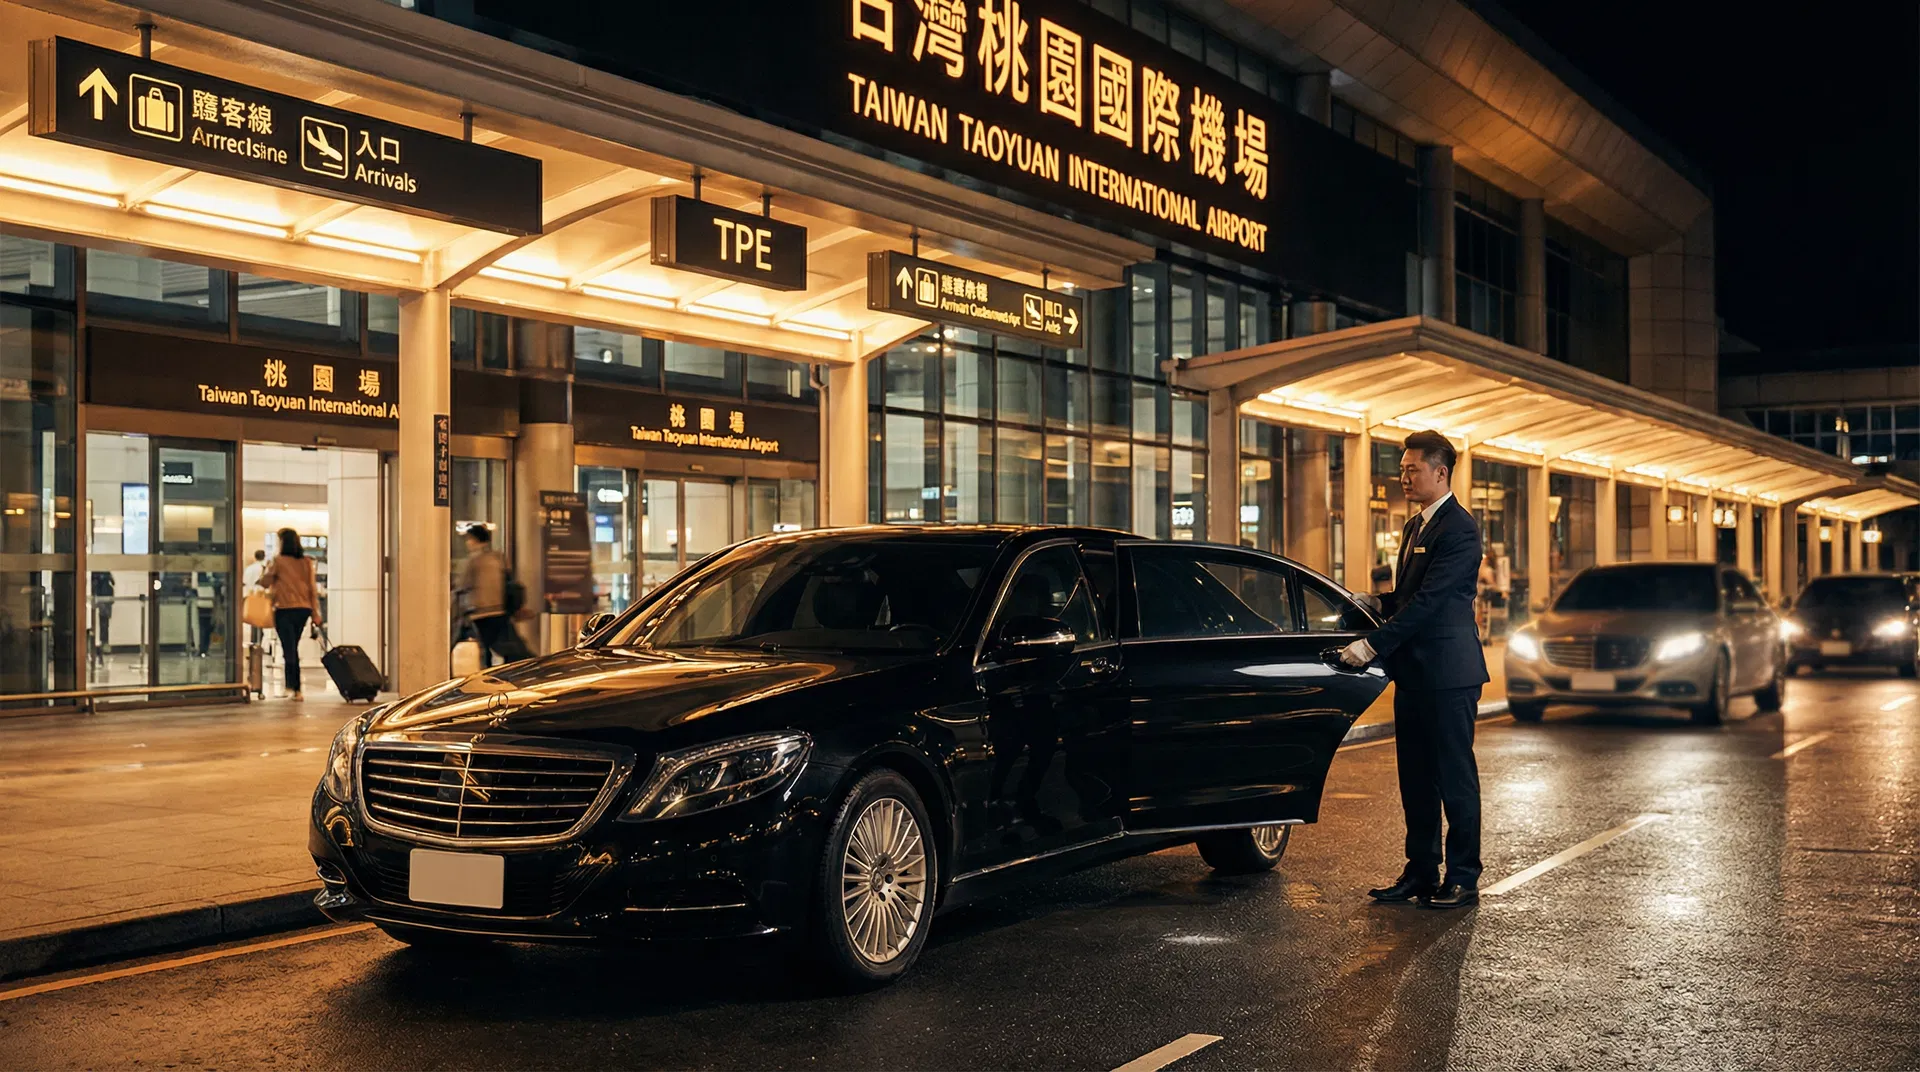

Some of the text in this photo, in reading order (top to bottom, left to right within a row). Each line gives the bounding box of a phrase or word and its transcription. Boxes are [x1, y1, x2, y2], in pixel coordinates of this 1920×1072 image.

[355, 130, 400, 165] 入口
[847, 72, 1268, 253] TAIWAN TAOYUAN INTERNATIONAL AIRPORT
[354, 163, 417, 194] Arrivals
[713, 217, 772, 271] TPE
[197, 384, 400, 419] Taiwan Taoyuan International A
[631, 425, 779, 455] Taiwan Taoyuan International Airport
